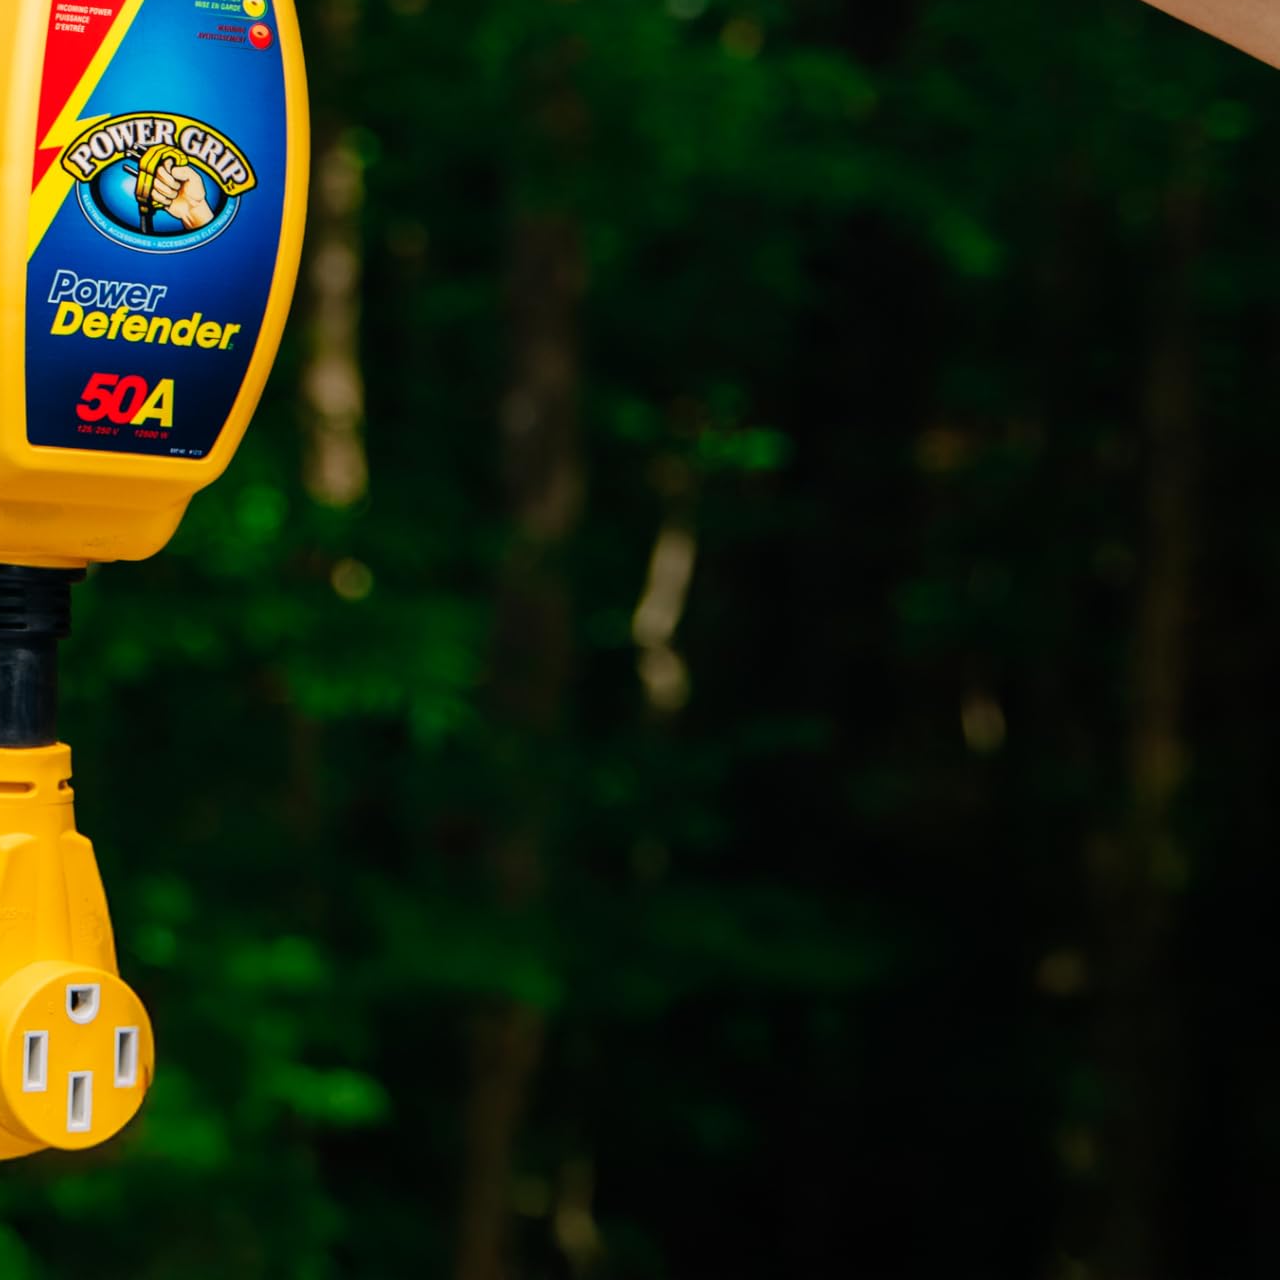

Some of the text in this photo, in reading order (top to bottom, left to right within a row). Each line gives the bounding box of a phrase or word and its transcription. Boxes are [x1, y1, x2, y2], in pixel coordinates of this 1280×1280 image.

[55, 13, 90, 24] PUISSANCE
[56, 3, 113, 16] INCOMING POWER
[69, 117, 249, 184] POWER GRIP
[47, 269, 168, 312] Power
[50, 300, 241, 350] Defender
[75, 372, 175, 428] 50A
